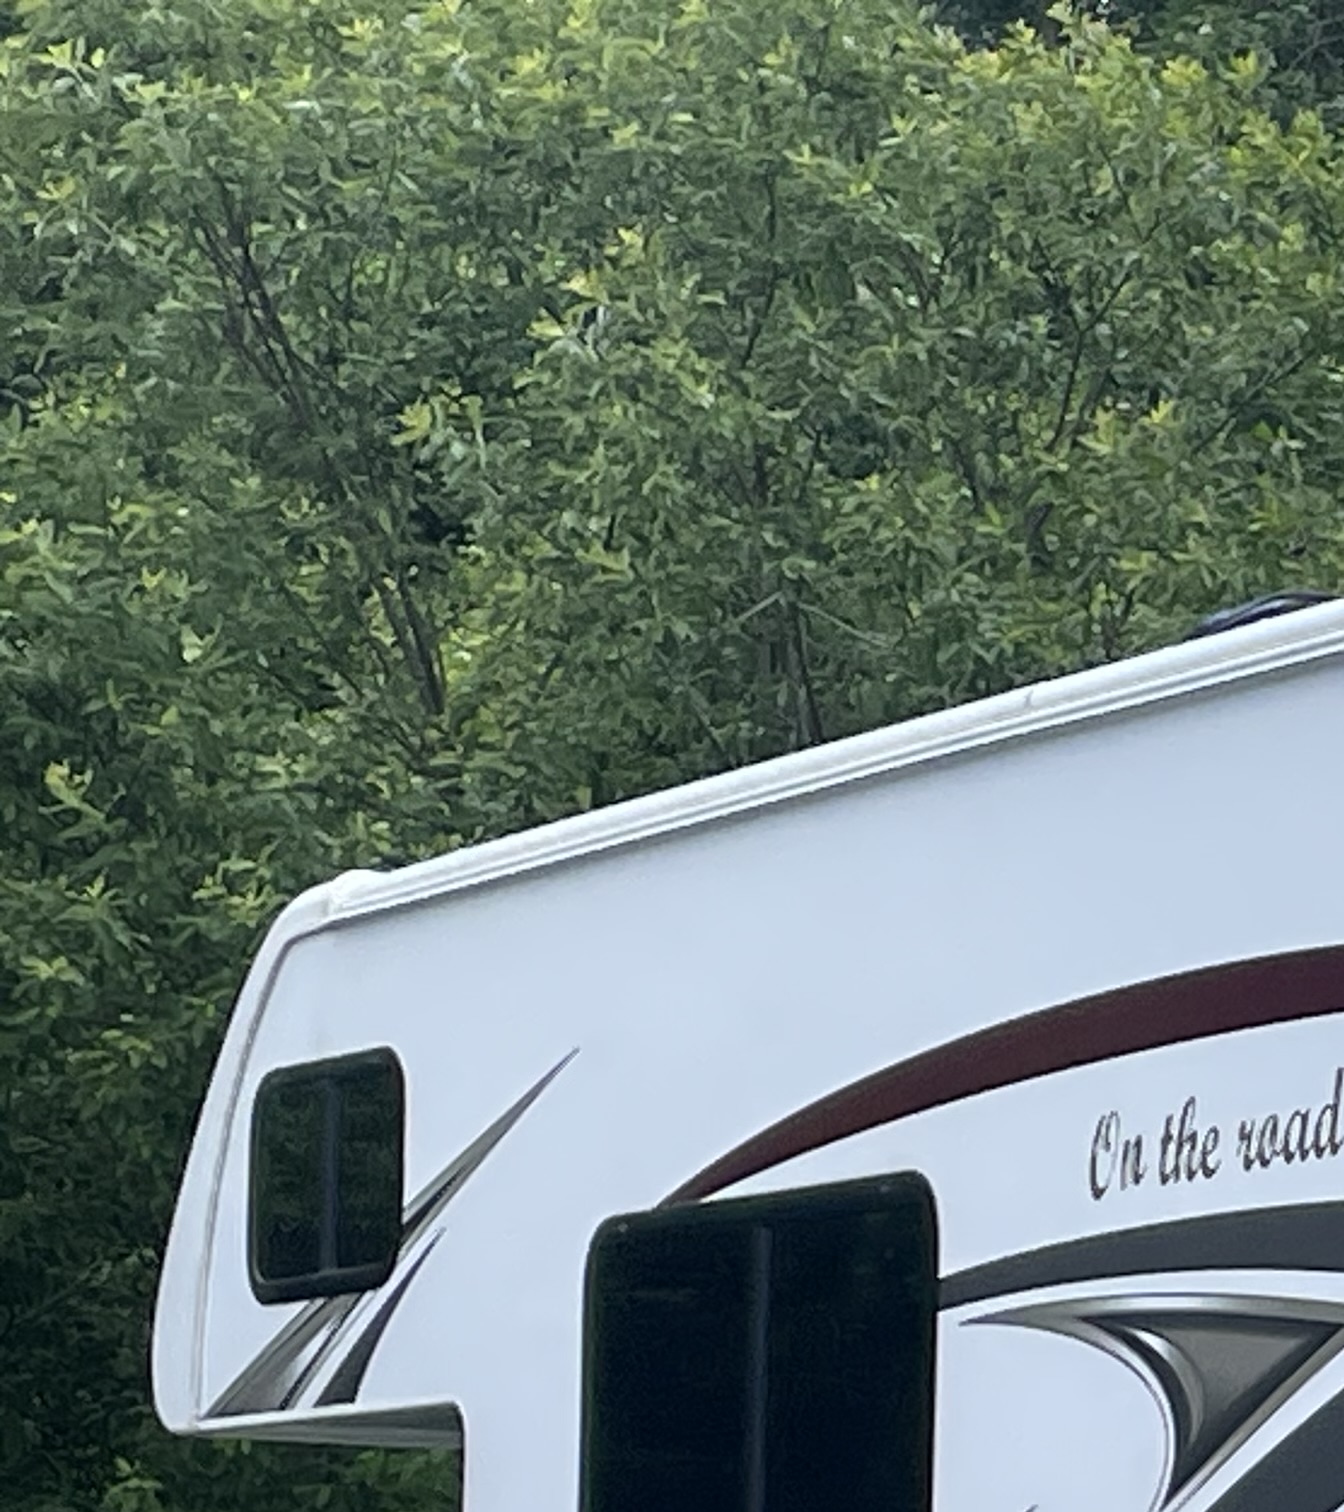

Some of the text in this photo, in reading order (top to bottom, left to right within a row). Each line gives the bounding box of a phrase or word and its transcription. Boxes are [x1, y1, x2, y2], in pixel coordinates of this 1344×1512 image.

[1088, 1110, 1147, 1201] On
[1158, 1095, 1222, 1187] the
[1236, 1066, 1344, 1166] road
